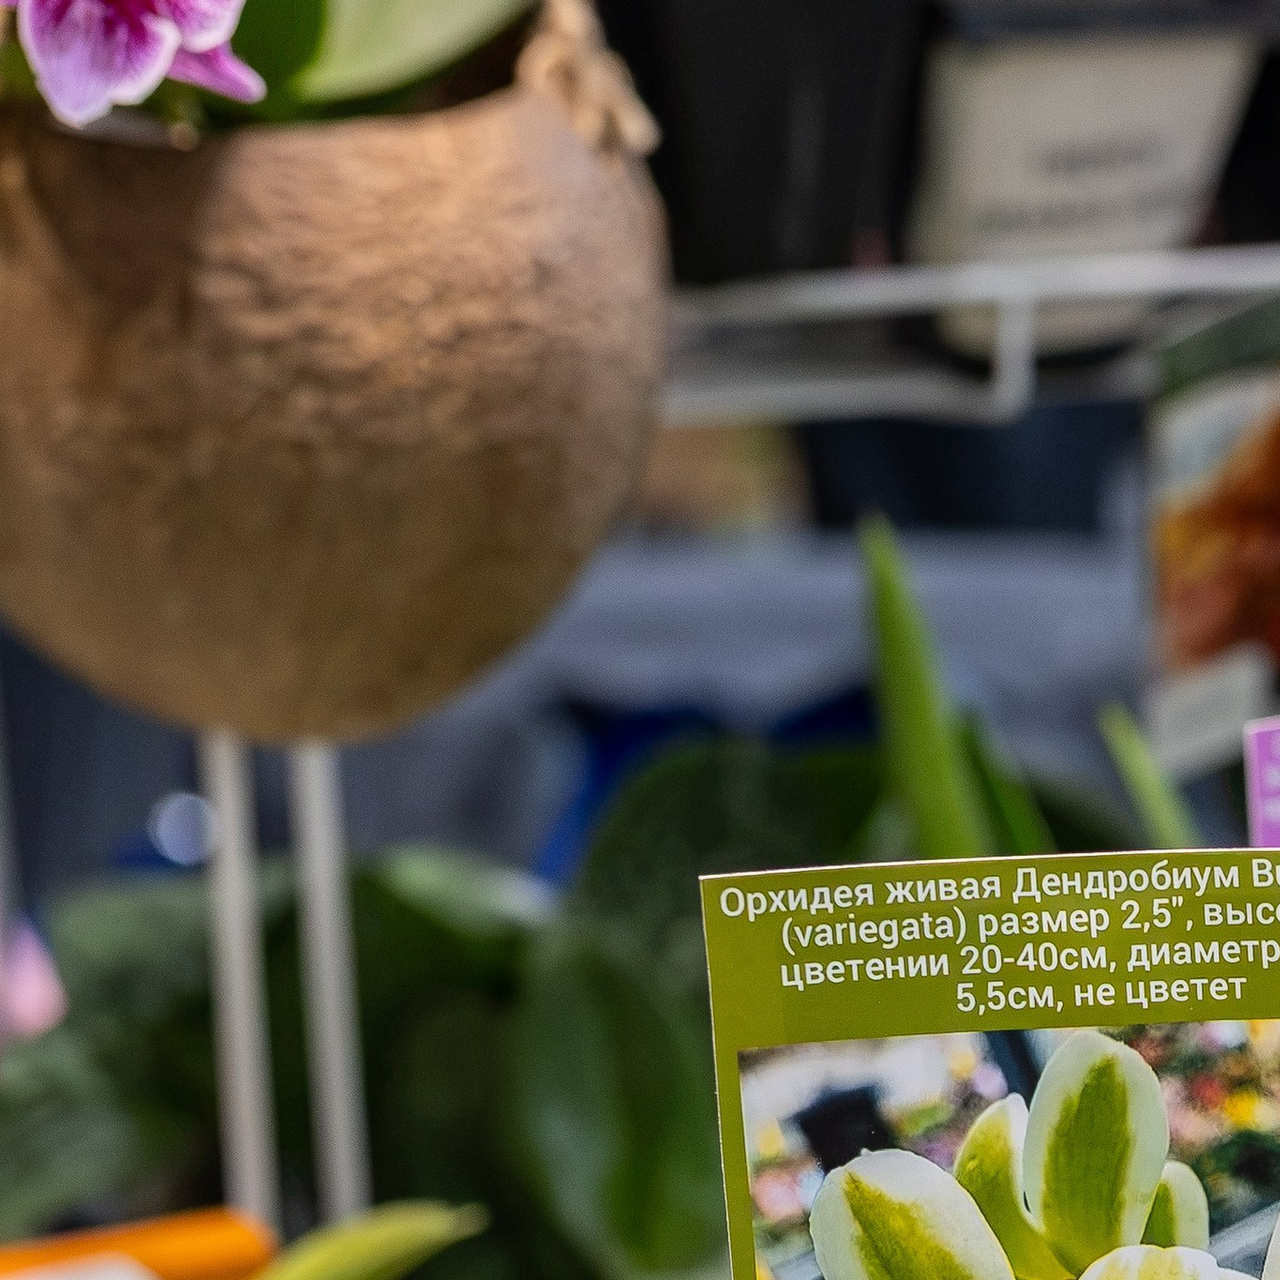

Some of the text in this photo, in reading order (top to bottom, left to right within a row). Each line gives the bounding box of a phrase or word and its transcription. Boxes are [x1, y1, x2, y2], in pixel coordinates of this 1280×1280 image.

[720, 883, 874, 922] Орхидея
[884, 876, 1001, 905] живая
[1012, 859, 1240, 904] Дендробиум
[782, 906, 967, 956] (variegata)
[978, 908, 1110, 944] размер
[780, 954, 949, 991] цветении
[960, 942, 1116, 976] 20-40см,
[1127, 939, 1280, 972] диаметр
[956, 977, 1247, 1017] 5,5см, не цветет
